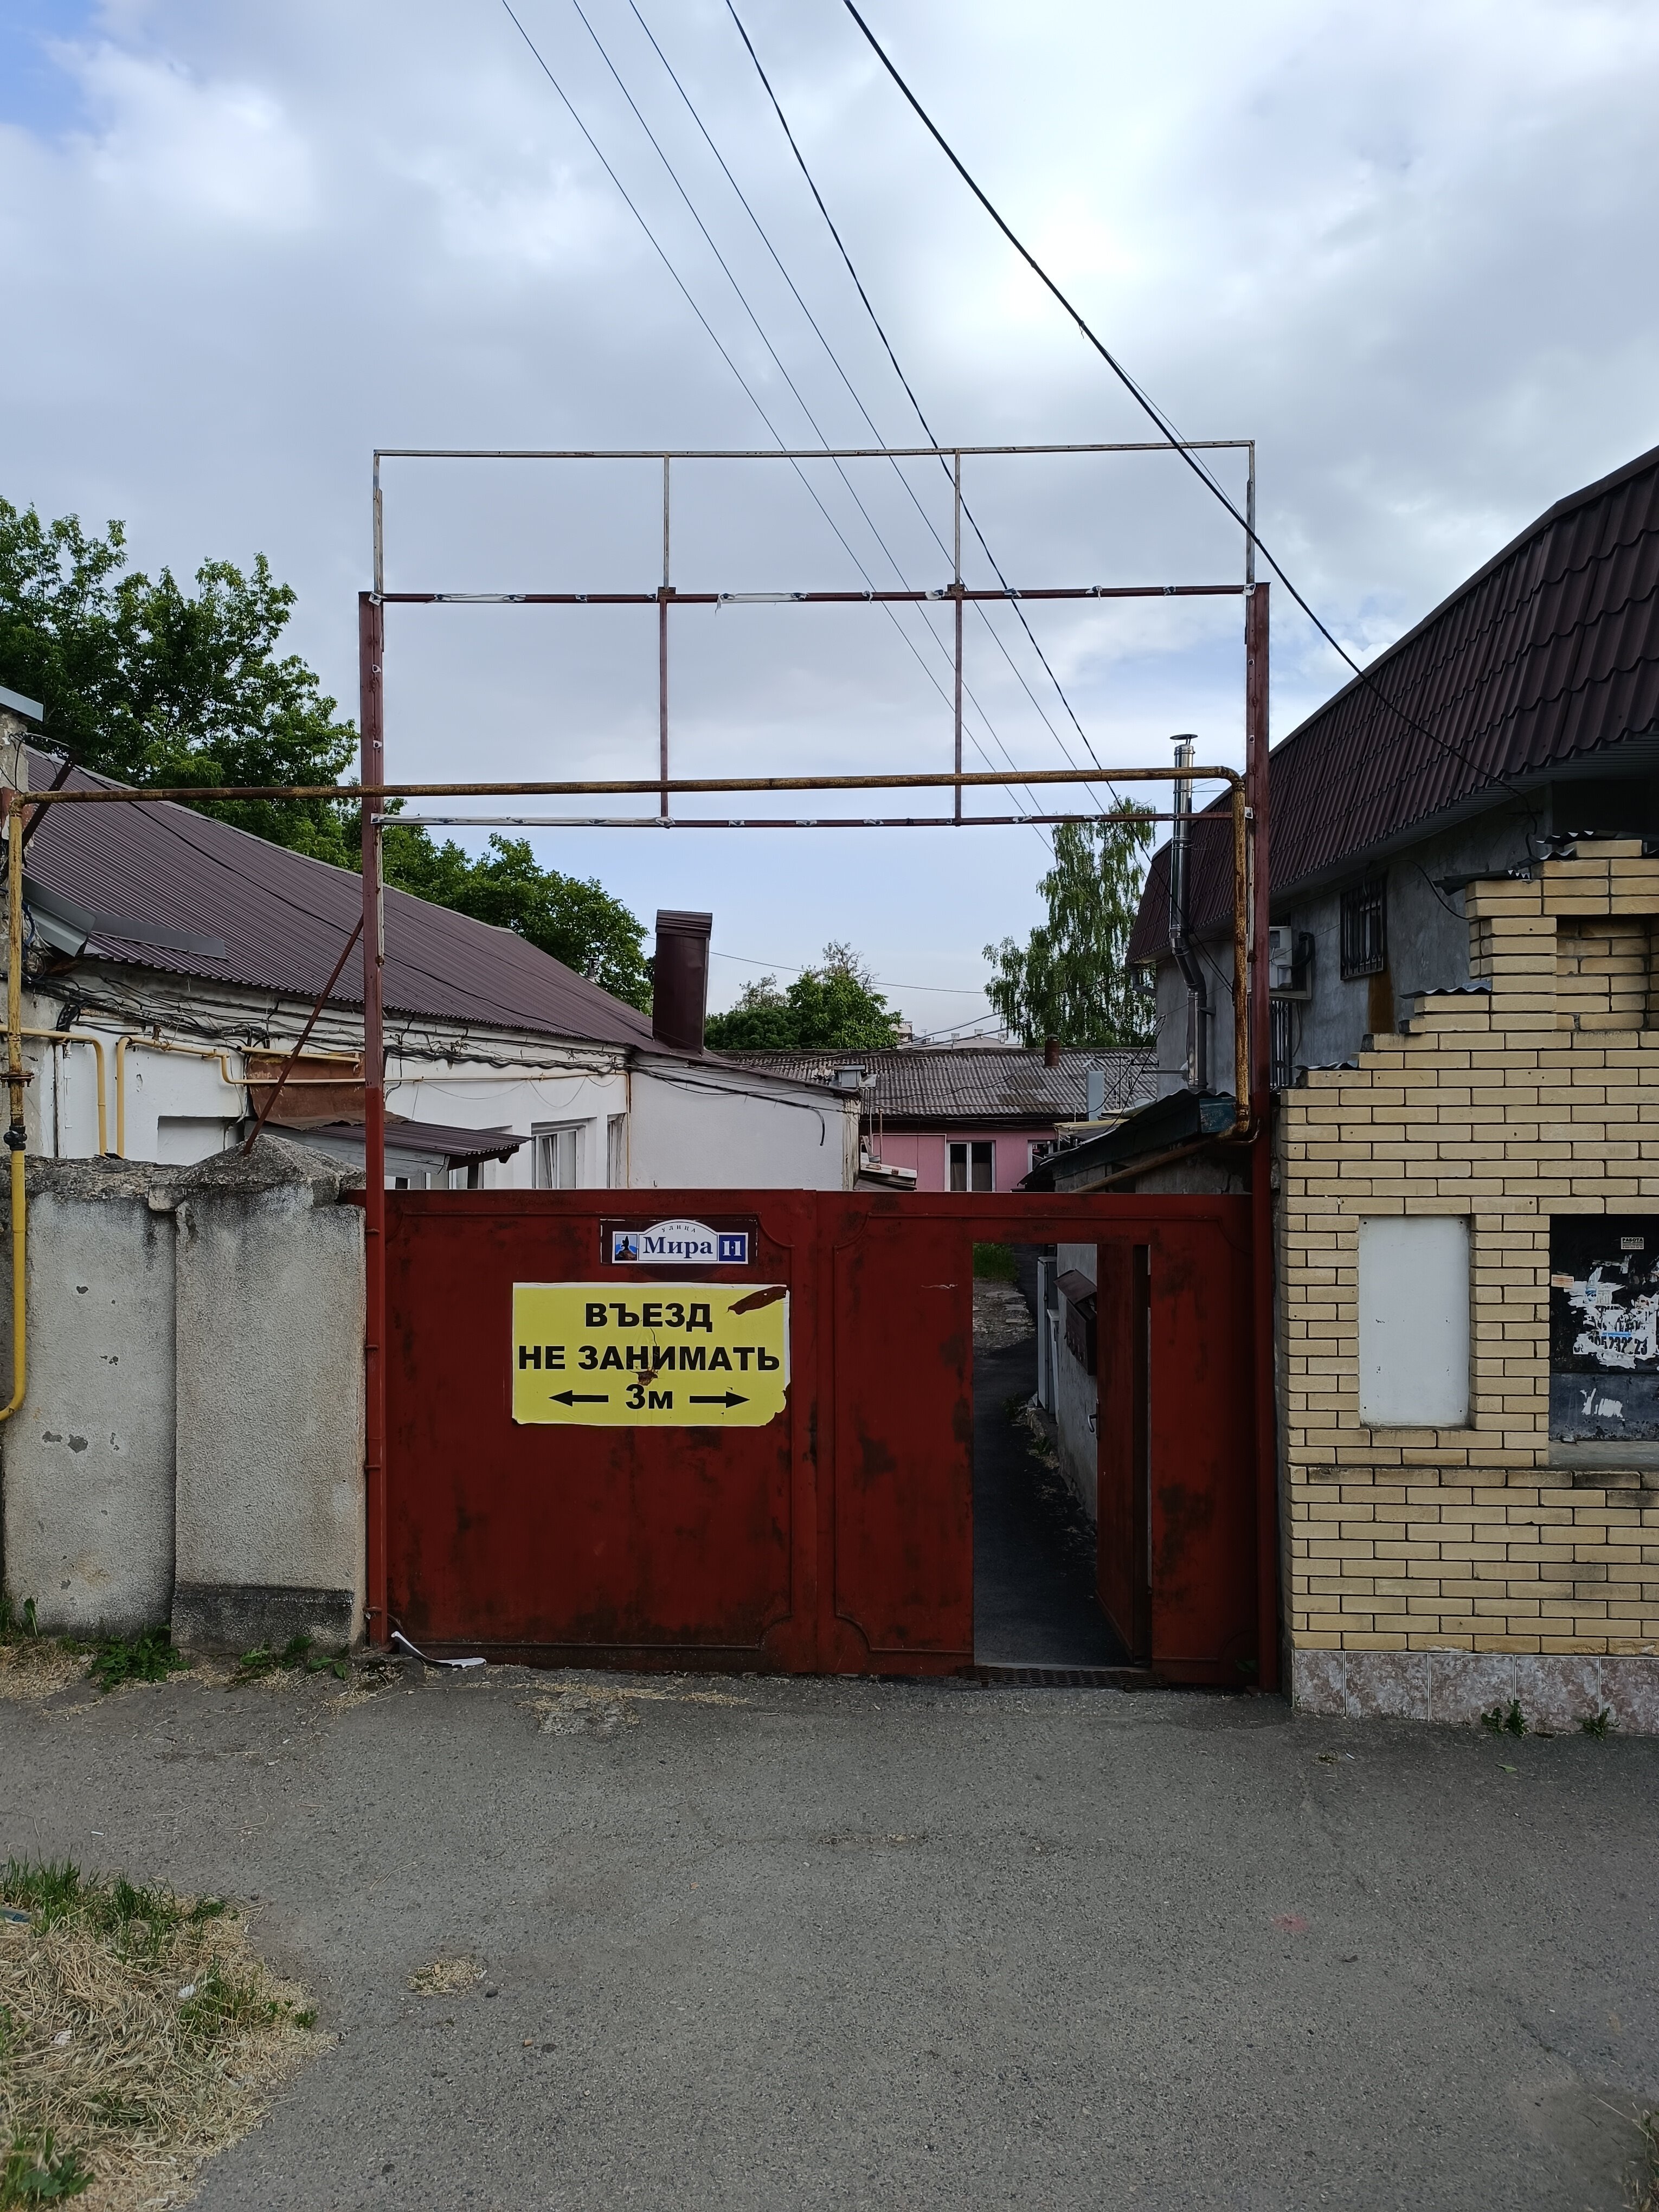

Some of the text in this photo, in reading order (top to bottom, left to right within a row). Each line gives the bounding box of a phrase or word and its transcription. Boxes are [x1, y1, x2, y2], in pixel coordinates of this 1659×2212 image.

[642, 1236, 742, 1259] Мира 11
[586, 1303, 713, 1333] ВЪЕЗД
[518, 1345, 780, 1371] НЕ ЗАНИМАТЬ
